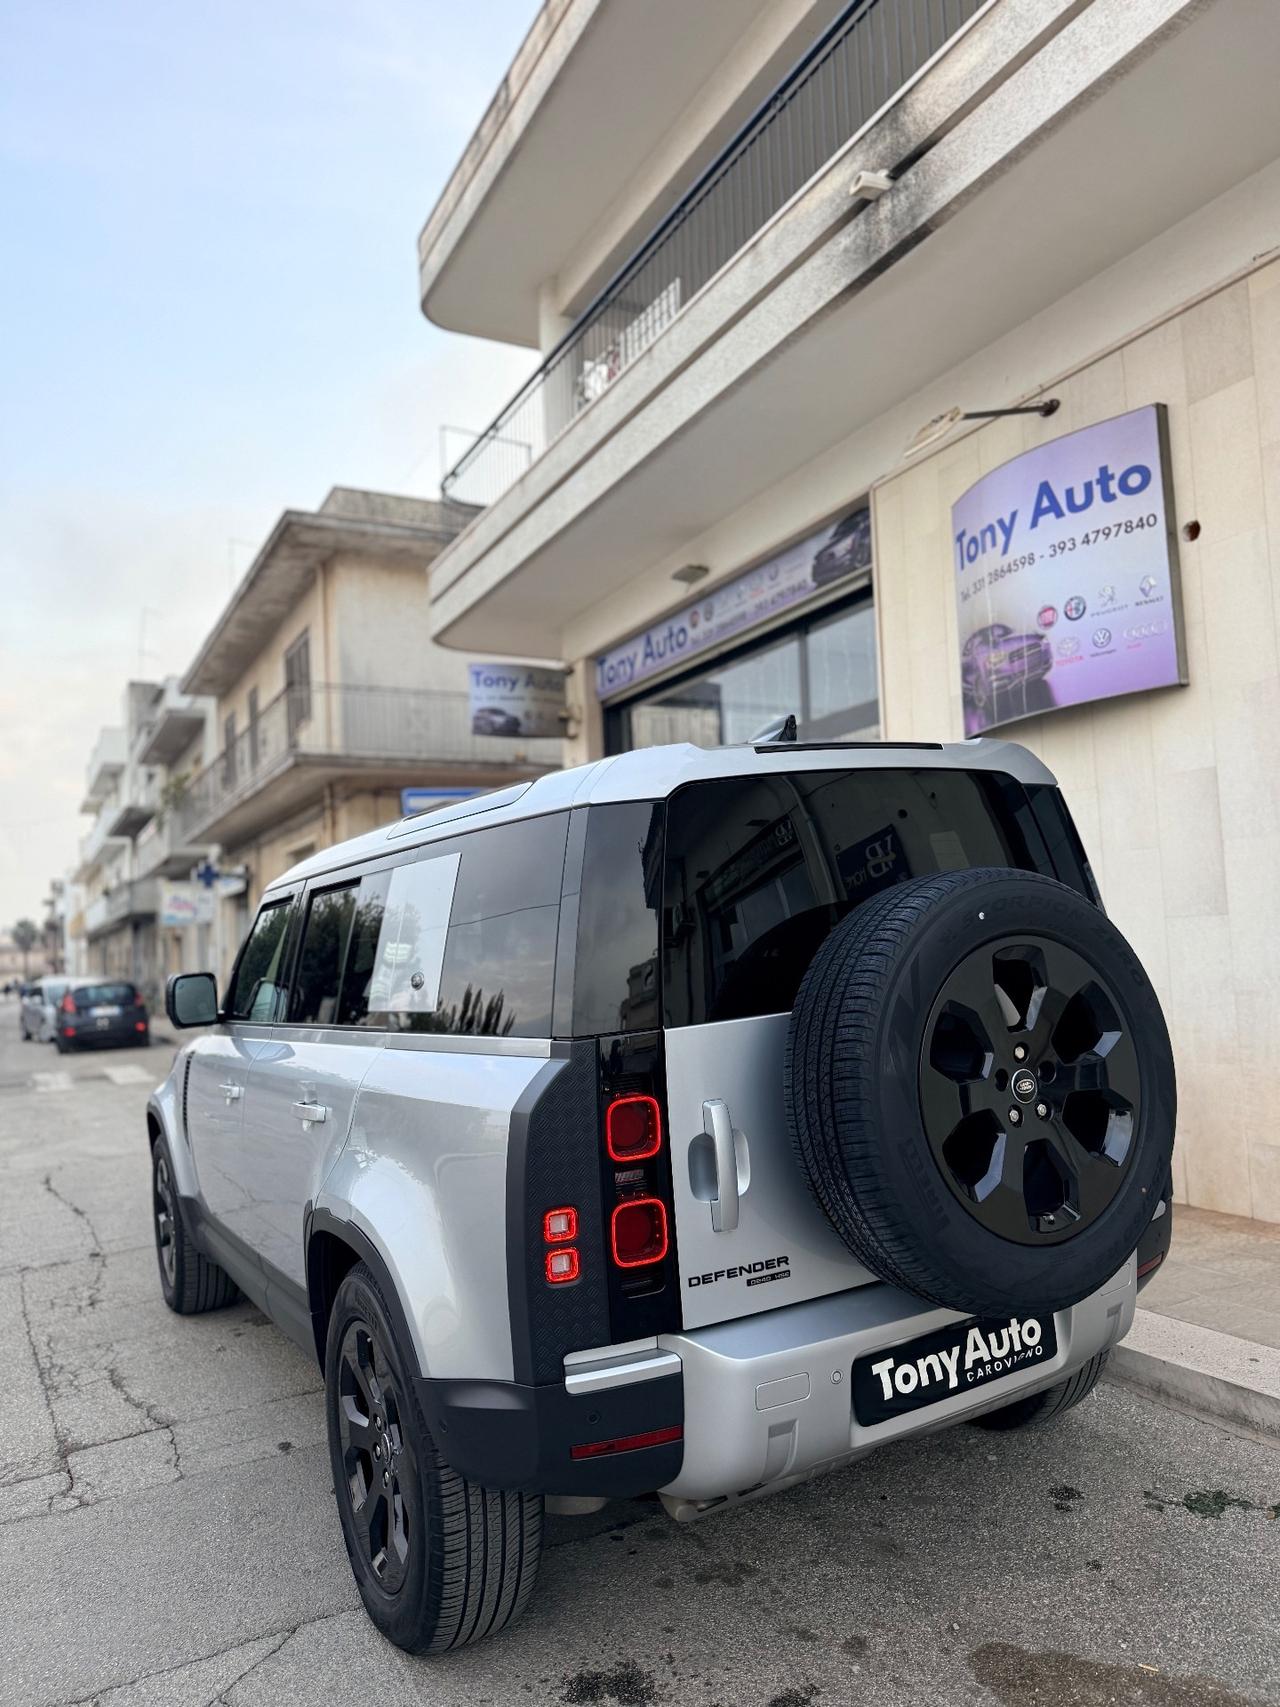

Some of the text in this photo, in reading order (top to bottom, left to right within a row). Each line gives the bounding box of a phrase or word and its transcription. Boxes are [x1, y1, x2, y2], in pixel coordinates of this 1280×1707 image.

[956, 464, 1152, 571] Tony Auto
[987, 552, 1035, 585] 2864598
[1049, 537, 1077, 559] 393
[1081, 513, 1158, 546] 4797840
[471, 671, 519, 693] Tony
[597, 627, 687, 689] Tony Auto
[687, 1255, 790, 1288] DEFENDER
